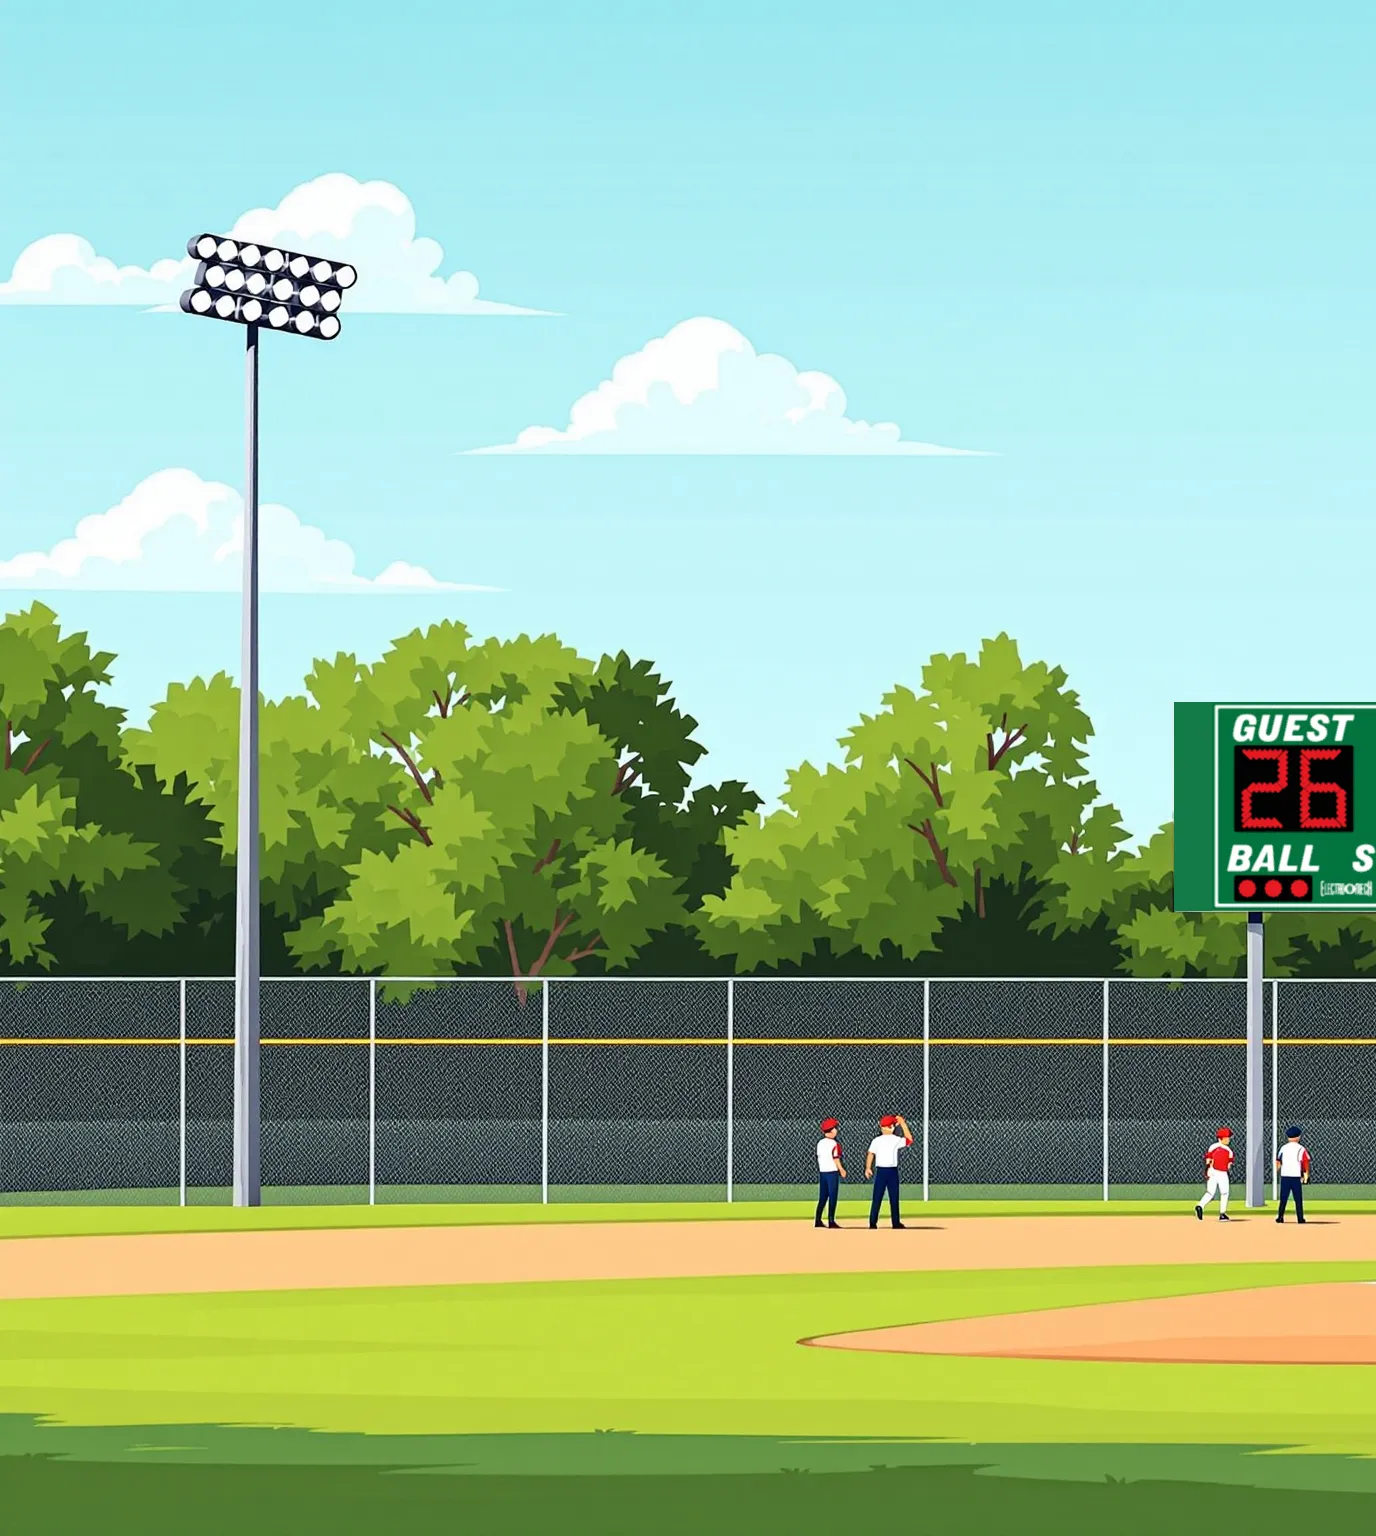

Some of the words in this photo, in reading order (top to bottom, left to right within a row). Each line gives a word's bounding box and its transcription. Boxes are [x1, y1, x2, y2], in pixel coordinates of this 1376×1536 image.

[1233, 714, 1354, 742] GUEST
[1242, 749, 1347, 828] 26
[1227, 844, 1320, 872] BALL
